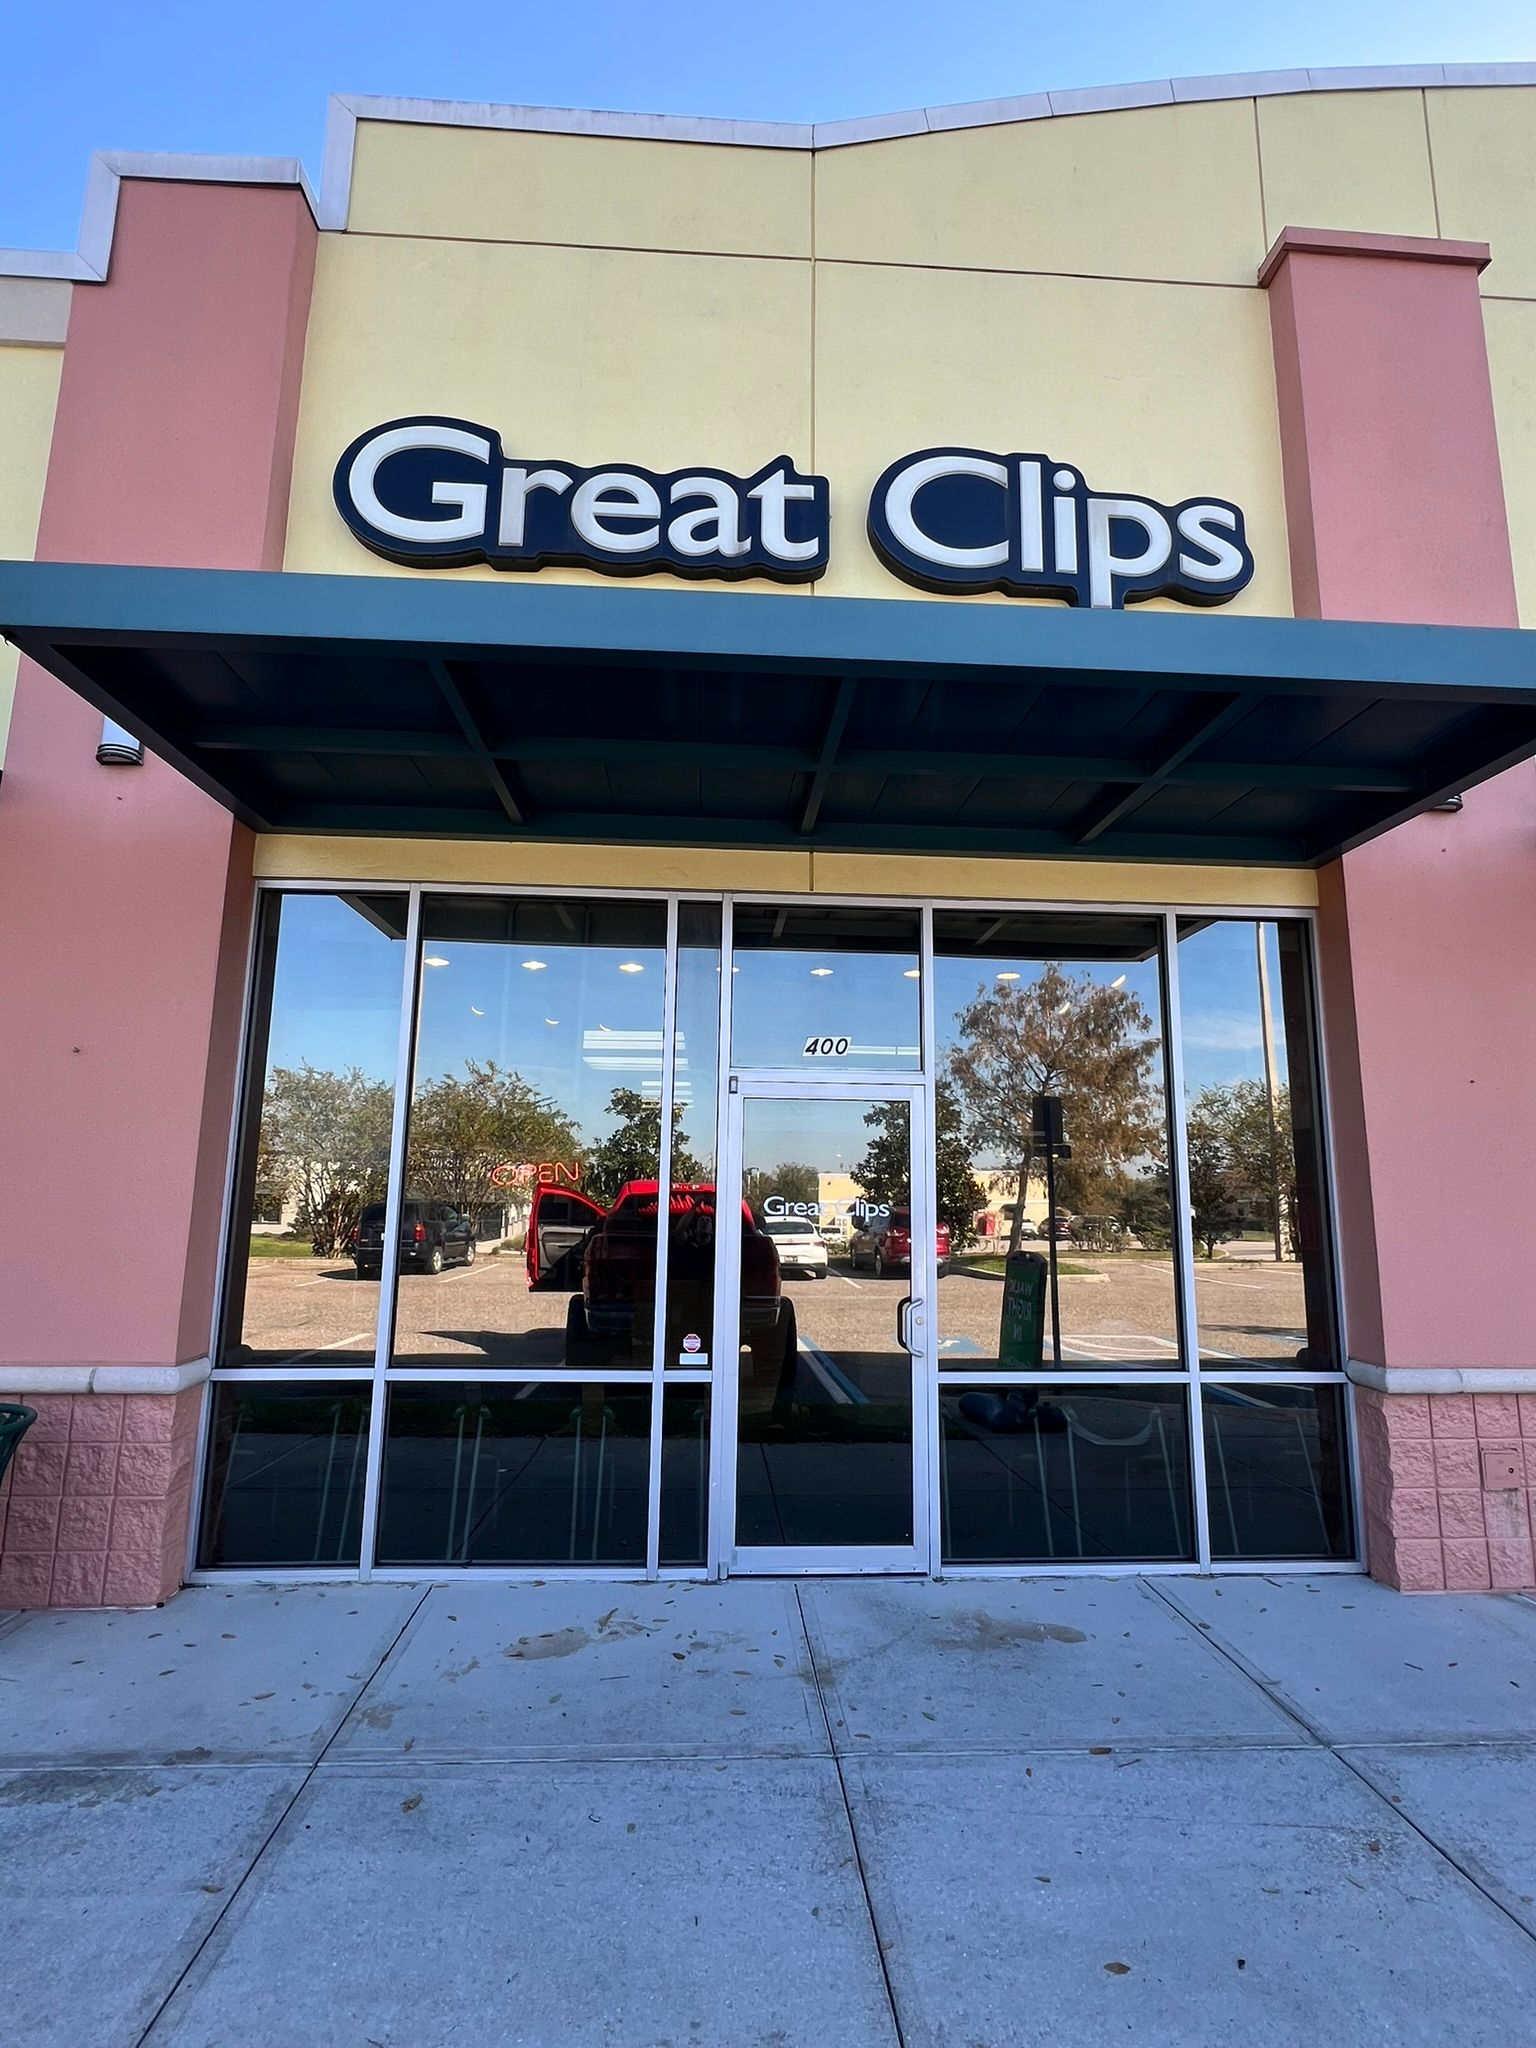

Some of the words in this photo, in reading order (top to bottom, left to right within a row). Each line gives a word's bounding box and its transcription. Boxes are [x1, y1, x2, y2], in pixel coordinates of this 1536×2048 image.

[348, 424, 820, 561] Great
[885, 455, 1243, 609] Clips
[804, 1037, 849, 1056] 400
[491, 1161, 580, 1186] OPEN
